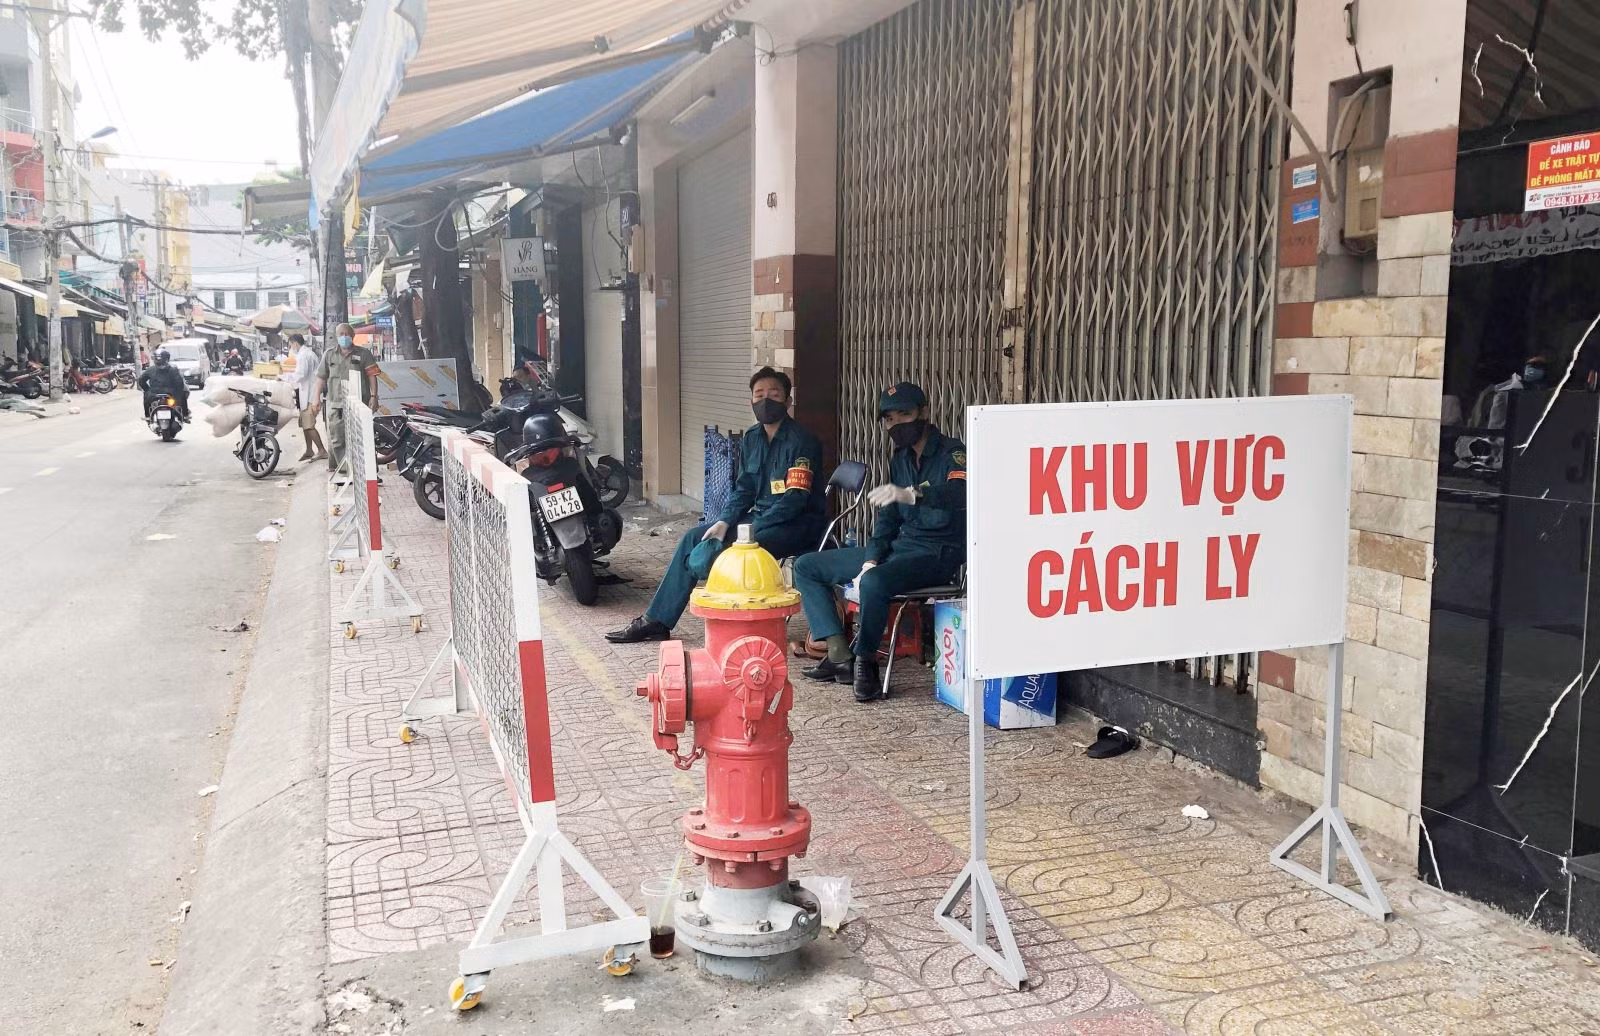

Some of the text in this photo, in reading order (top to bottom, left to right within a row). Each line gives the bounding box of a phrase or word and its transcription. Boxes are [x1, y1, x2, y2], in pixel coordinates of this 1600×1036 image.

[1553, 158, 1563, 168] XE
[1029, 433, 1285, 515] KHU VỰC
[545, 490, 574, 507] 59-K2
[547, 500, 581, 520] 044.28
[1027, 531, 1260, 618] CÁCH LY
